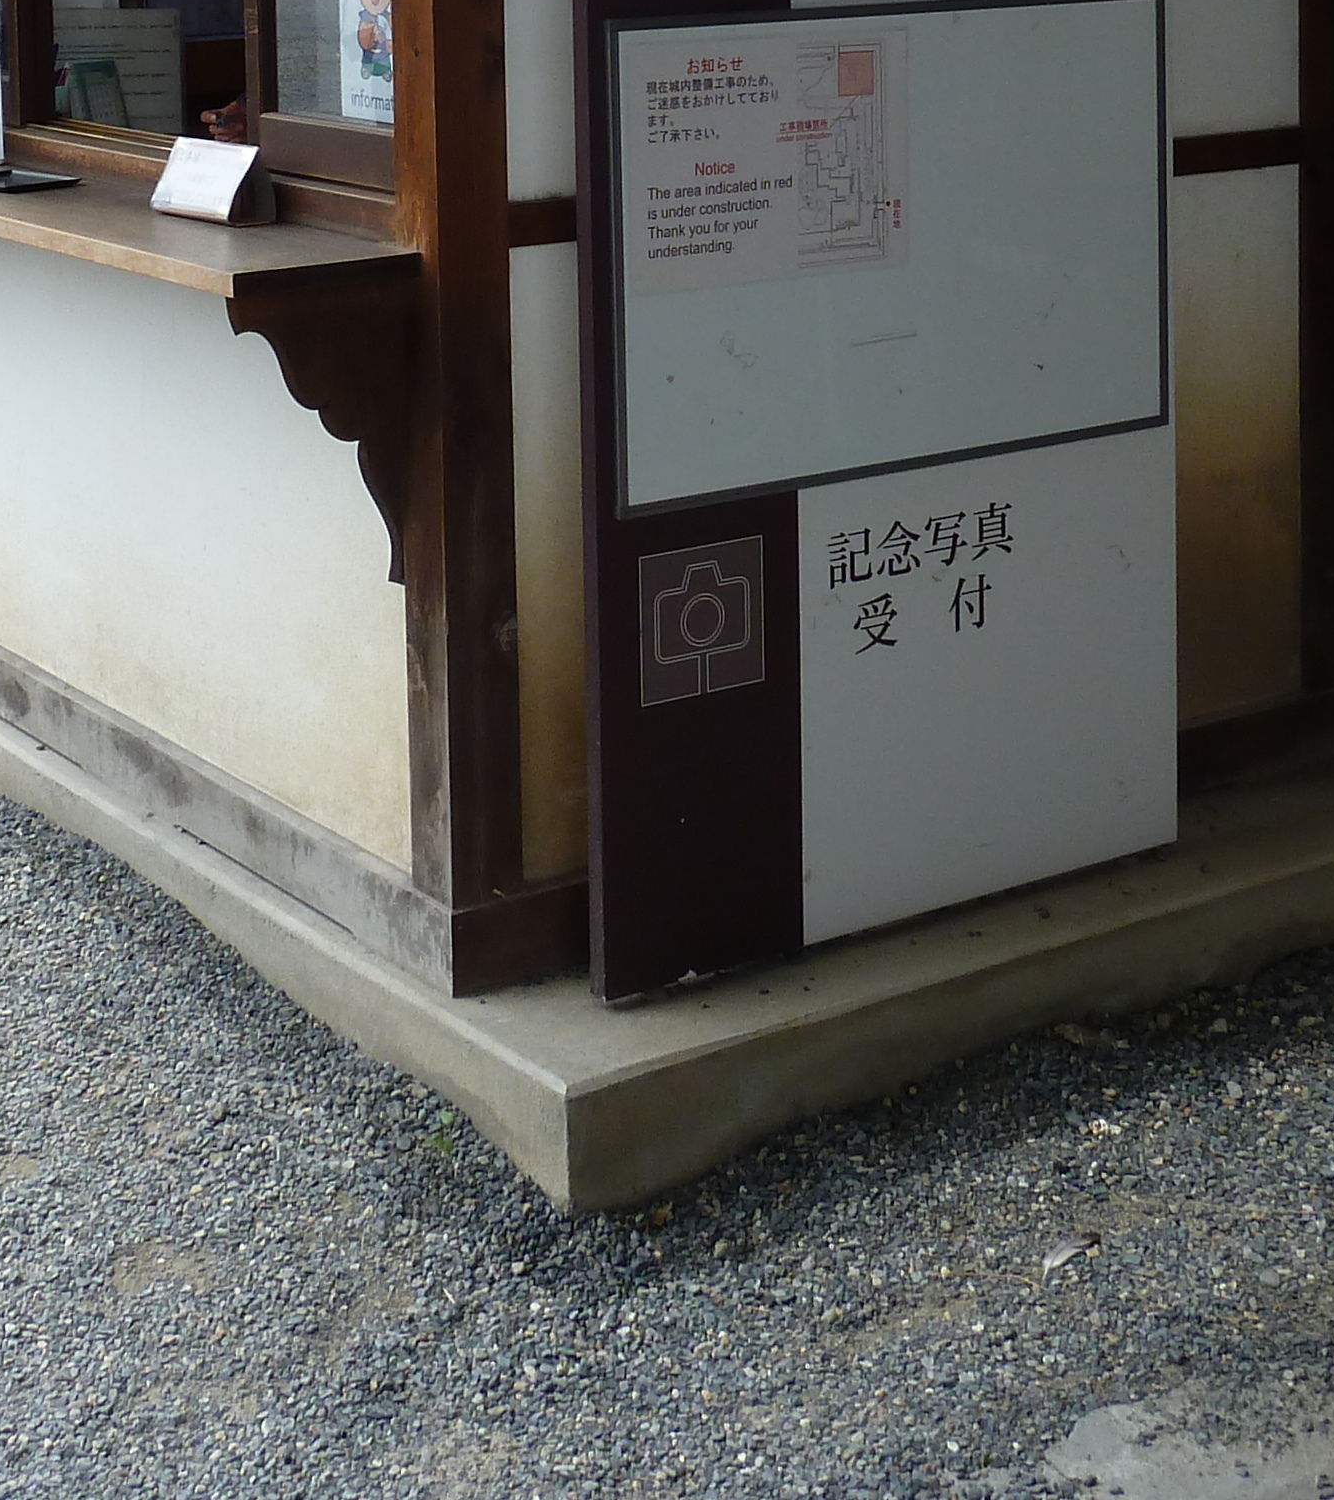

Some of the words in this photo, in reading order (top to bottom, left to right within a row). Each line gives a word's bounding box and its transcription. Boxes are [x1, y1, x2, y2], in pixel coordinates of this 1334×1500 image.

[686, 57, 744, 74] お知らせ
[693, 161, 736, 176] Notice
[647, 187, 671, 201] The
[674, 186, 702, 199] area
[705, 179, 757, 196] indicated
[760, 178, 771, 190] in
[774, 175, 793, 189] red
[647, 210, 658, 221] is
[661, 205, 696, 220] under
[699, 198, 773, 215] construction.
[647, 225, 686, 239] Thank
[689, 225, 711, 239] you
[714, 220, 730, 233] for
[732, 219, 759, 235] your
[827, 502, 1015, 591] 記念写真
